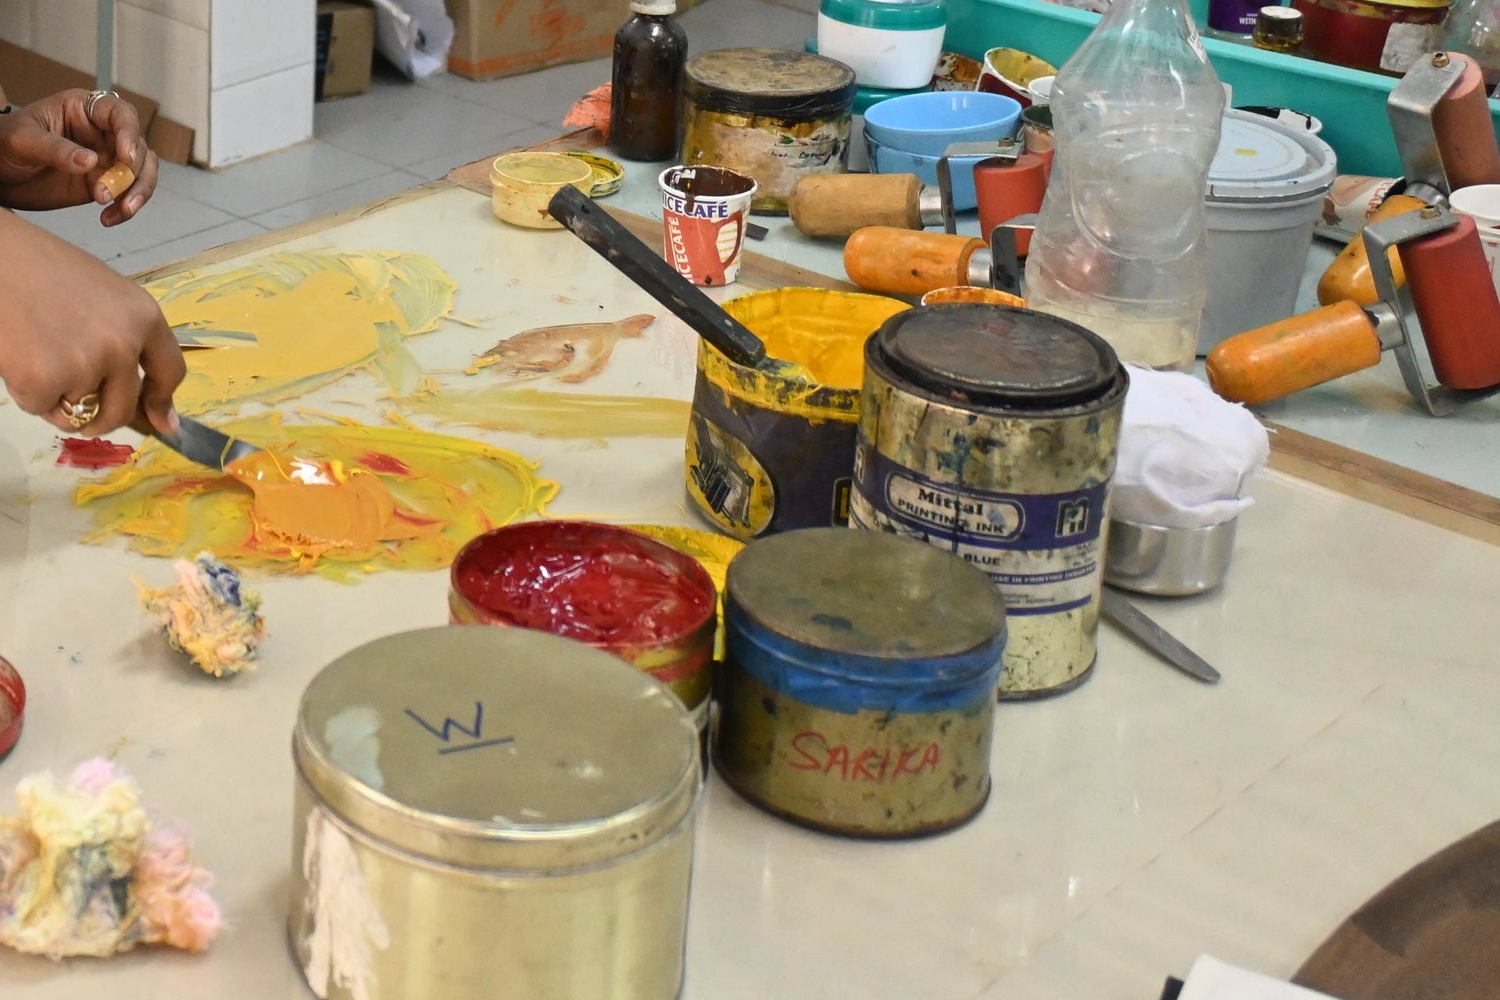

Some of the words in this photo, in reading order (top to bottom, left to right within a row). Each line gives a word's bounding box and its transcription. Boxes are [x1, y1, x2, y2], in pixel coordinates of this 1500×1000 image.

[1239, 16, 1257, 25] WITH
[663, 191, 729, 218] ICECAFÉ
[918, 488, 983, 515] Mittal
[976, 522, 1004, 534] INK
[963, 553, 1001, 566] BLUE
[405, 701, 483, 741] W
